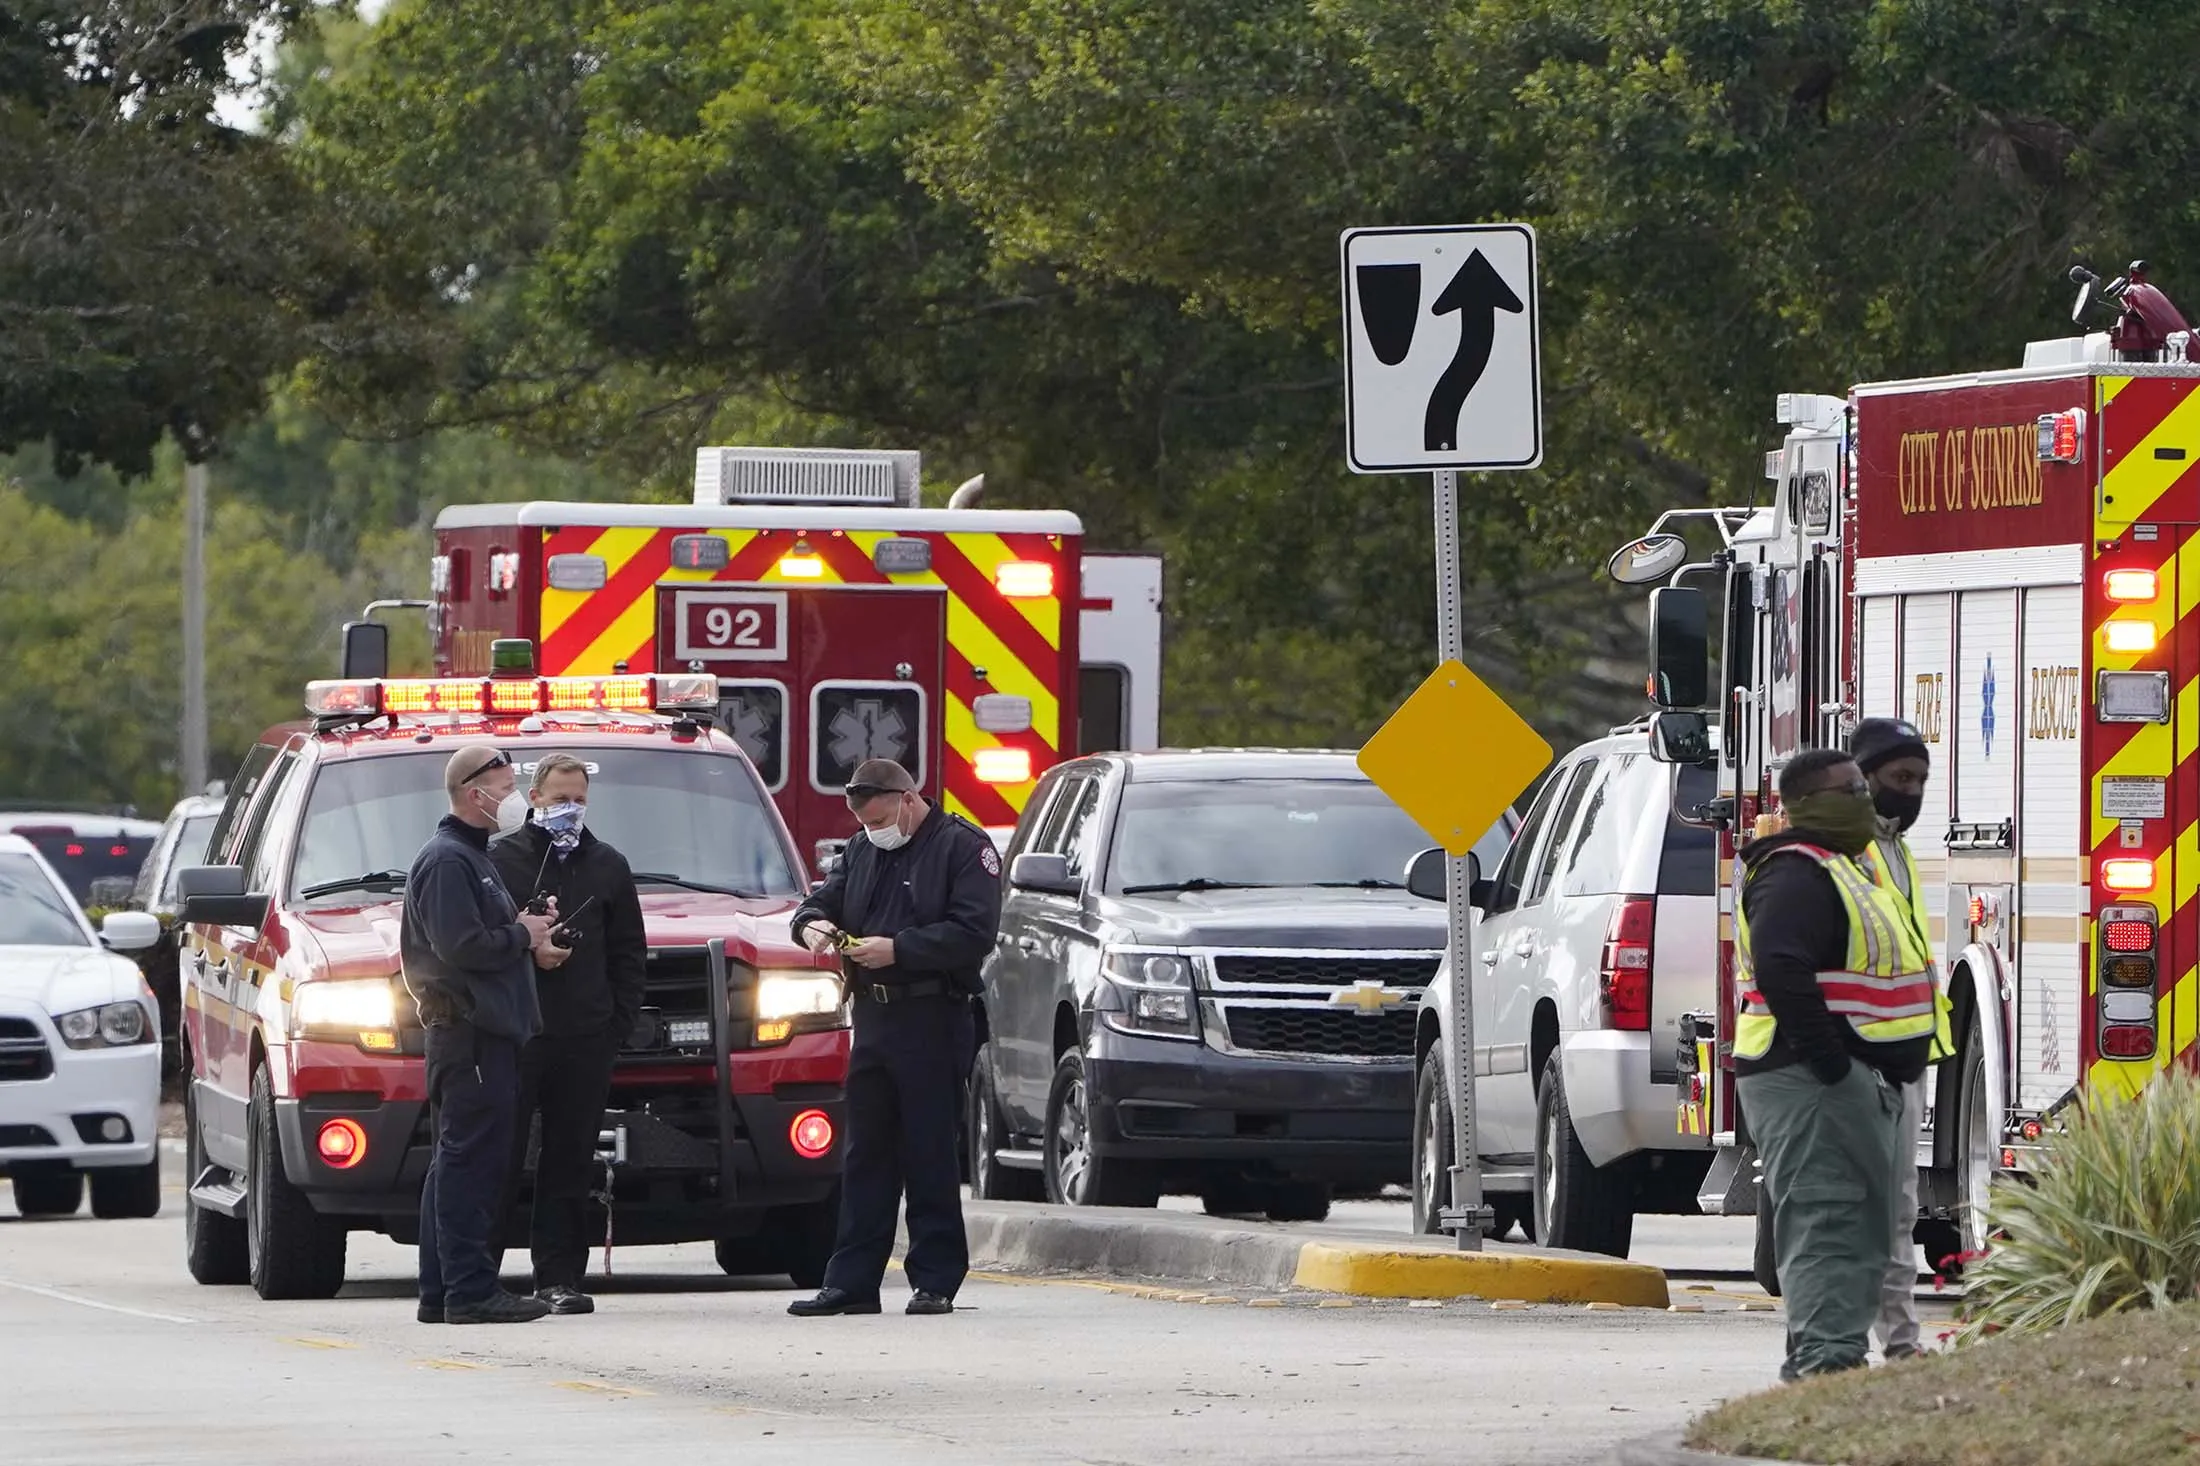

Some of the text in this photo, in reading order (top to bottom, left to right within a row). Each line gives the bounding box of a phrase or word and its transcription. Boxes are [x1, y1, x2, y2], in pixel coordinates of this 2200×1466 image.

[1899, 431, 1939, 514] CITY
[1944, 428, 1966, 511] OF
[706, 607, 760, 646] 92
[1915, 665, 2079, 743] FIRE RESCUE
